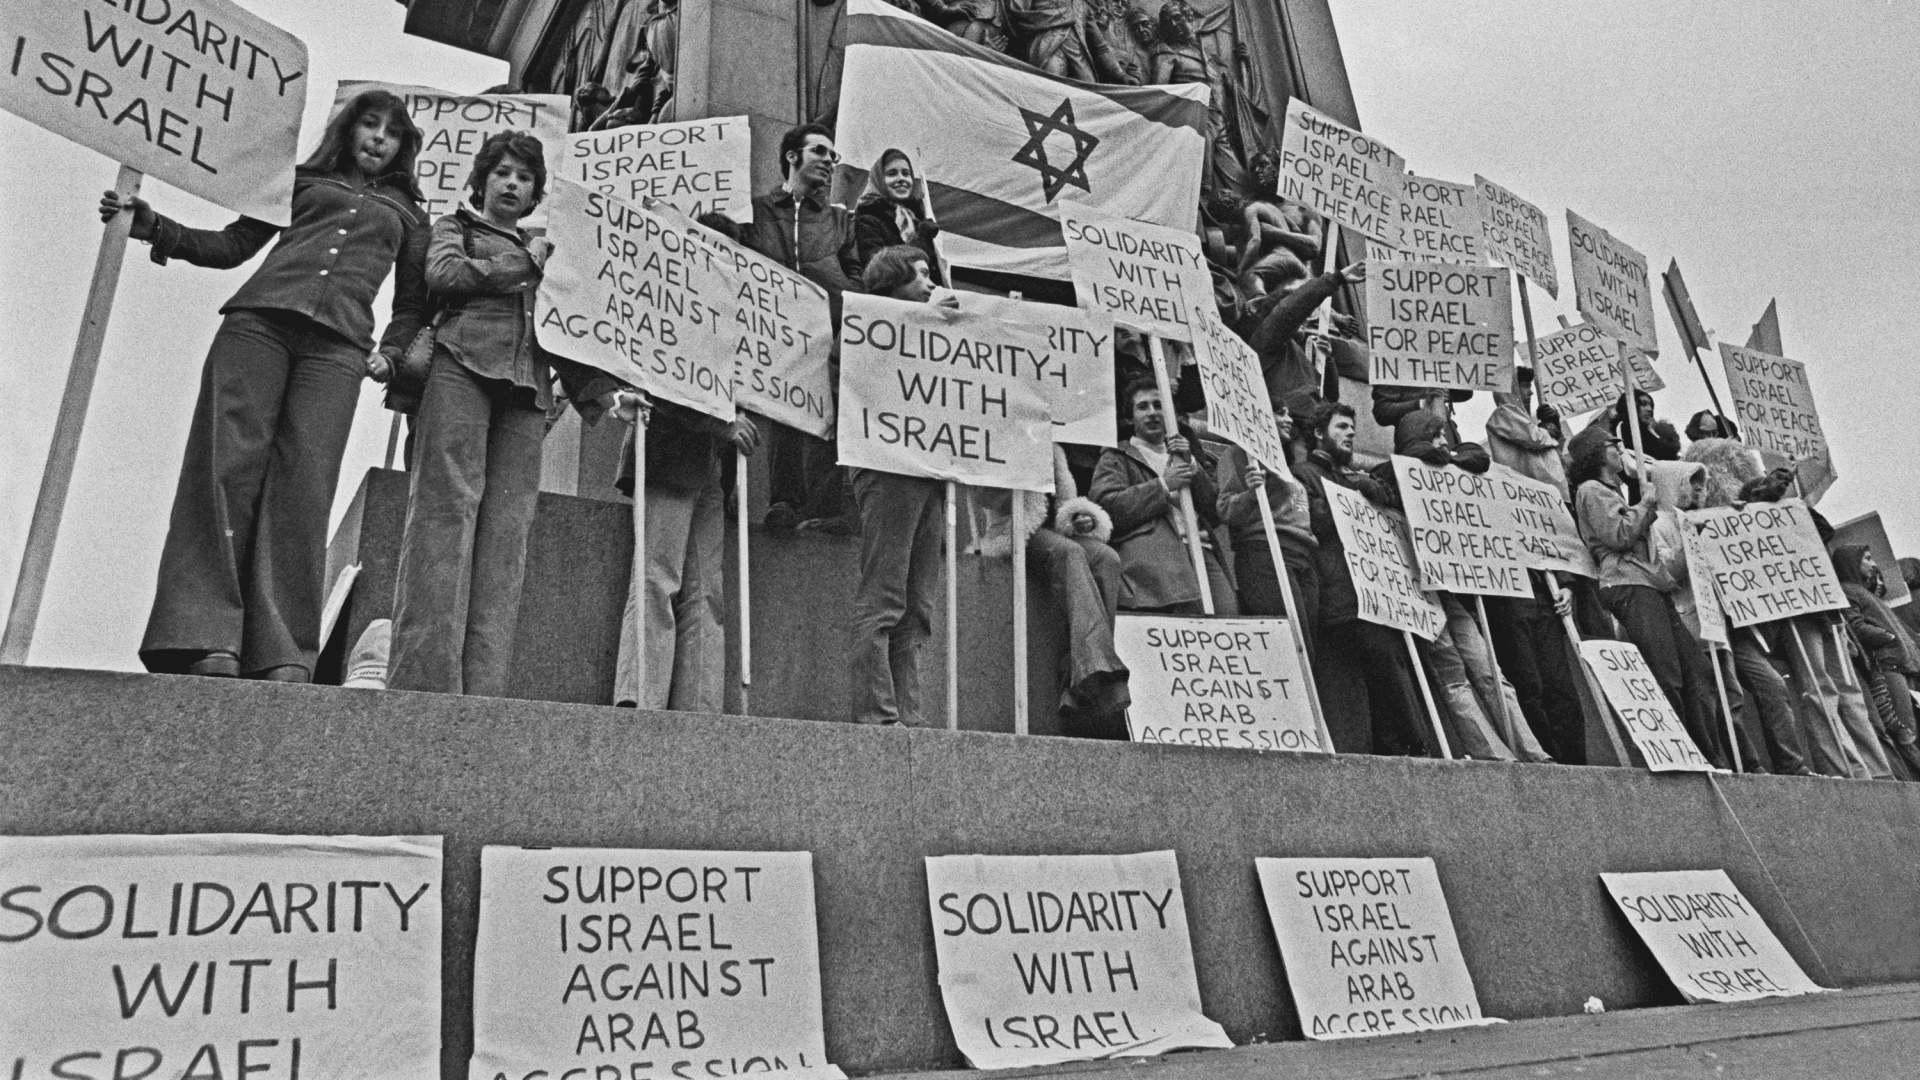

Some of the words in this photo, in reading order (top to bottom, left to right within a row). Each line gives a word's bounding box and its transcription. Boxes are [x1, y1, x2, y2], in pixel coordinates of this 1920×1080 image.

[84, 10, 234, 122] WITH
[11, 36, 218, 174] ISRAEL
[405, 94, 547, 128] PPORT
[574, 123, 730, 157] SUPPORT
[1298, 111, 1396, 167] SUPPORT
[582, 151, 698, 181] ISRAEL
[1303, 136, 1374, 183] ISRAEL
[631, 170, 733, 200] PEACE
[1283, 151, 1323, 185] FOR
[1331, 172, 1392, 216] PEACE
[1283, 175, 1304, 200] IN
[1401, 203, 1452, 229] RAEL
[1485, 184, 1544, 230] SUPPORT
[585, 192, 715, 272] SUPPORT
[1414, 229, 1477, 256] PEACE
[1491, 206, 1538, 245] ISRAEL
[597, 225, 698, 295] ISRAEL
[1066, 219, 1200, 269] SOLIDARITY
[1482, 221, 1510, 247] FOR
[1514, 237, 1552, 273] PEACE
[1572, 227, 1647, 288] SOLIDARITY
[1109, 257, 1182, 292] WITH
[1382, 269, 1497, 298] SUPPORT
[1598, 266, 1638, 308] WITH
[597, 260, 720, 334] AGAINST
[737, 282, 788, 320] AEL
[1093, 283, 1190, 325] ISRAEL
[1390, 298, 1476, 326] ISRAEL
[1588, 287, 1642, 337] ISRAEL
[606, 293, 678, 346] ARAB
[736, 308, 812, 354] AINST
[541, 307, 733, 402] AGGRESSION
[736, 336, 772, 367] AB
[844, 314, 1050, 381] SOLIDARITY
[1195, 306, 1258, 375] SUPPORT
[1370, 327, 1417, 351] FOR
[1428, 329, 1499, 358] PEACE
[1207, 341, 1257, 399] ISRAEL
[1374, 357, 1399, 380] IN
[1544, 345, 1614, 377] ISRAEL
[1732, 352, 1801, 384] SUPPORT
[898, 368, 1006, 418] WITH
[1201, 364, 1235, 408] FOR
[1234, 389, 1276, 440] PEACE
[1743, 377, 1798, 407] ISRAEL
[1211, 400, 1230, 432] IN
[1736, 400, 1769, 424] FOR
[1771, 408, 1817, 435] PEACE
[863, 407, 1006, 464] ISRAEL
[1744, 426, 1762, 447] IN
[1408, 467, 1496, 500] SUPPORT
[1502, 481, 1564, 513] DARITY
[1337, 493, 1409, 542] SUPPORT
[1422, 499, 1492, 528] ISRAEL
[1704, 506, 1798, 539] SUPPORT
[1351, 525, 1410, 569] ISRAEL
[1414, 527, 1454, 557] FOR
[1459, 533, 1517, 561] PEACE
[1516, 530, 1570, 561] RAEL
[1720, 534, 1796, 565] ISRAEL
[1348, 552, 1384, 587] FOR
[1422, 561, 1445, 585] IN
[1715, 569, 1765, 595] FOR
[1763, 556, 1826, 584] PEACE
[1360, 586, 1378, 616] IN
[1731, 597, 1758, 622] IN
[1146, 628, 1270, 651] SUPPORT
[1160, 653, 1262, 675] ISRAEL
[1171, 677, 1290, 700] AGAINST
[1184, 702, 1256, 725] ARAB
[1620, 708, 1673, 732] FOR
[1642, 740, 1673, 764] IN
[543, 866, 761, 904] SUPPORT
[1296, 869, 1411, 898] SUPPORT
[0, 881, 430, 942] SOLIDARITY
[938, 888, 1173, 937] SOLIDARITY
[1313, 903, 1410, 932] ISRAEL
[1621, 892, 1749, 923] SOLIDARITY
[560, 913, 732, 953] ISRAEL
[1678, 924, 1758, 959] WITH
[1331, 935, 1439, 968] AGAINST
[112, 958, 337, 1019] WITH
[562, 958, 775, 1004] AGAINST
[1013, 951, 1138, 995] WITH
[1348, 971, 1415, 1004] ARAB
[1687, 968, 1789, 995] ISRAEL
[576, 1009, 705, 1055] ARAB
